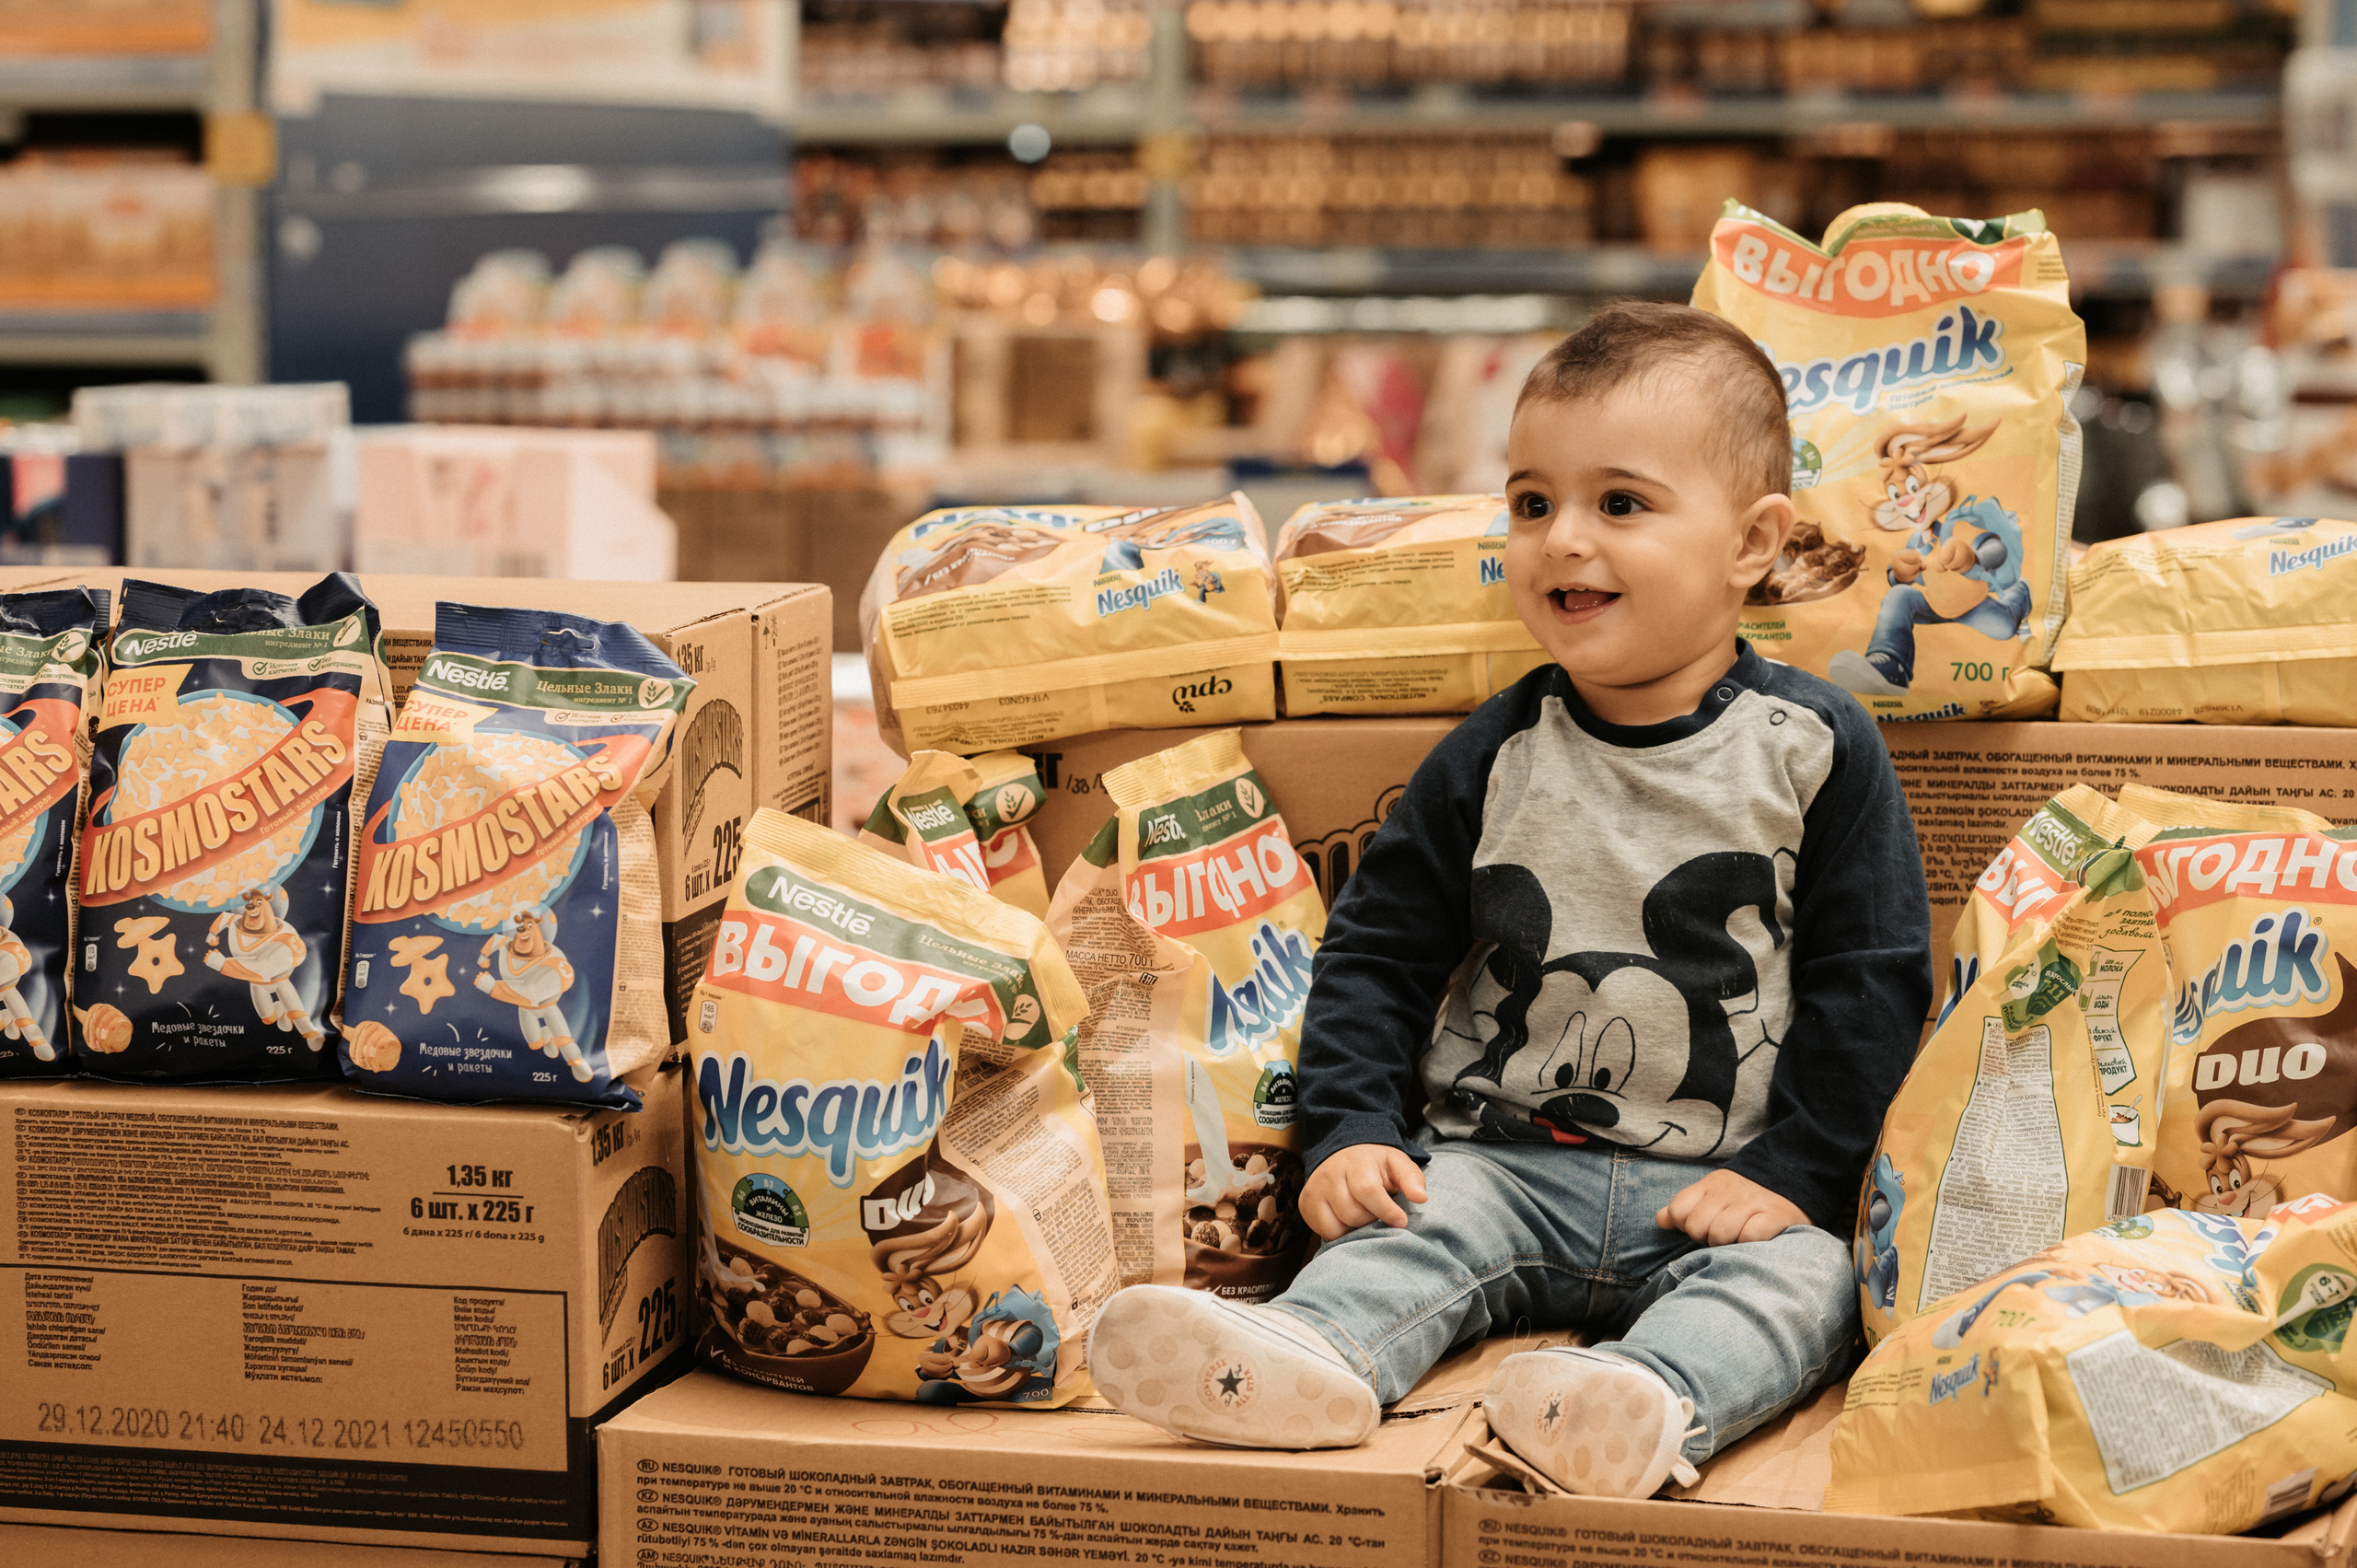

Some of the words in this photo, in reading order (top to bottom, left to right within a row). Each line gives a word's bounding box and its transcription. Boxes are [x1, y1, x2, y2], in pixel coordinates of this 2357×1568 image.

[1733, 232, 1996, 307] ВЫГОДНО
[1760, 305, 2005, 416] esquik
[1097, 567, 1186, 618] Nesquik
[1737, 619, 1786, 630] РАСИТЕЛЕЙ
[288, 628, 330, 640] Злаки
[427, 658, 507, 691] Nestlé
[1950, 662, 1992, 681] 700
[107, 677, 167, 698] СУПЕР
[536, 679, 591, 694] Цельные
[594, 681, 633, 695] Злаки
[573, 696, 616, 704] ингредиент
[401, 698, 469, 721] СУПЕР
[1933, 750, 1982, 762] ЗАВТРАК,
[1986, 751, 2073, 764] ОБОГАЩЕННЫЙ
[2076, 755, 2153, 765] ВИТАМИНАМИ
[2155, 756, 2163, 765] И
[2166, 757, 2261, 768] МИНЕРАЛЬНЫМИ
[2265, 759, 2346, 770] ВЕЩЕСТВАМИ.
[1963, 766, 2018, 775] влажности
[2022, 767, 2063, 777] воздуха
[1927, 779, 1996, 791] МИНЕРАЛДЫ
[2001, 781, 2064, 792] ЗАТТАРМЕН
[2229, 784, 2271, 796] ДАЙЫН
[296, 784, 331, 811] завтрак
[85, 718, 347, 897] KOSMOSTARS
[361, 752, 624, 913] KOSMOSTARS
[1918, 818, 1965, 830] saxlamaq
[768, 875, 876, 937] Nestlé
[918, 934, 988, 966] Цельные
[1065, 949, 1097, 962] МАССА
[1097, 953, 1127, 965] НЕТТО
[1129, 953, 1148, 967] 700
[712, 920, 993, 1038] ВЫГОД
[702, 1004, 714, 1015] 165
[2094, 1000, 2110, 1009] ВОДЫ
[151, 1020, 196, 1036] Медовые
[197, 1022, 245, 1037] звездочки
[192, 1035, 226, 1049] ракеты
[2094, 1034, 2114, 1042] ФРУКТ
[266, 1045, 286, 1055] 225
[419, 1042, 461, 1058] Медовые
[463, 1046, 513, 1061] звездочки
[458, 1060, 493, 1074] ракеты
[532, 1071, 552, 1083] 225
[447, 1165, 487, 1188] 1,35
[492, 1170, 513, 1188] кг
[411, 1197, 424, 1218] 6
[428, 1202, 463, 1221] шт.
[482, 1200, 521, 1223] 225
[526, 1206, 534, 1223] г
[749, 1195, 790, 1217] ВИТАМИНЫ
[756, 1211, 783, 1223] ЖЕЛЕЗО
[402, 1227, 410, 1236] 6
[445, 1229, 463, 1237] 225
[483, 1231, 508, 1240] dona
[517, 1232, 536, 1241] 225
[538, 1235, 545, 1244] g
[737, 1222, 805, 1246] СООБРАЗИТЕЛЬНОСТИ
[25, 1272, 41, 1281] Дата
[1222, 1286, 1236, 1295] БЕЗ
[1237, 1283, 1274, 1295] КРАСИТЕЛ
[454, 1296, 468, 1305] Код
[470, 1297, 505, 1307] продукта/
[638, 1275, 675, 1365] 225
[734, 1366, 815, 1391] КОНСЕРВАНТОВ
[456, 1383, 482, 1392] Рамзи
[1022, 1388, 1050, 1400] 700
[1236, 1393, 1250, 1408] ALL
[38, 1402, 169, 1438] 29.12.2020
[179, 1410, 245, 1443] 21:40
[259, 1414, 390, 1450] 24.12.2021
[404, 1419, 523, 1451] 12450550
[637, 1476, 657, 1486] при
[660, 1478, 730, 1491] температуре
[733, 1482, 746, 1491] не
[749, 1483, 781, 1493] выше
[784, 1484, 796, 1493] 20
[825, 1488, 911, 1502] относительной
[913, 1494, 974, 1504] влажности
[728, 1467, 785, 1480] ГОТОВЫЙ
[789, 1470, 876, 1486] ШОКОЛАДНЫЙ
[879, 1475, 935, 1490] ЗАВТРАК,
[938, 1480, 1033, 1495] ОБОГАЩЕННЫЙ
[1037, 1485, 1120, 1501] ВИТАМИНАМИ
[1124, 1492, 1132, 1501] И
[1136, 1492, 1240, 1508] МИНЕРАЛЬНЫМИ
[1243, 1498, 1332, 1514] ВЕЩЕСТВАМИ.
[1336, 1504, 1386, 1517] Хранить
[1575, 1528, 1636, 1543] ГОТОВЫЙ
